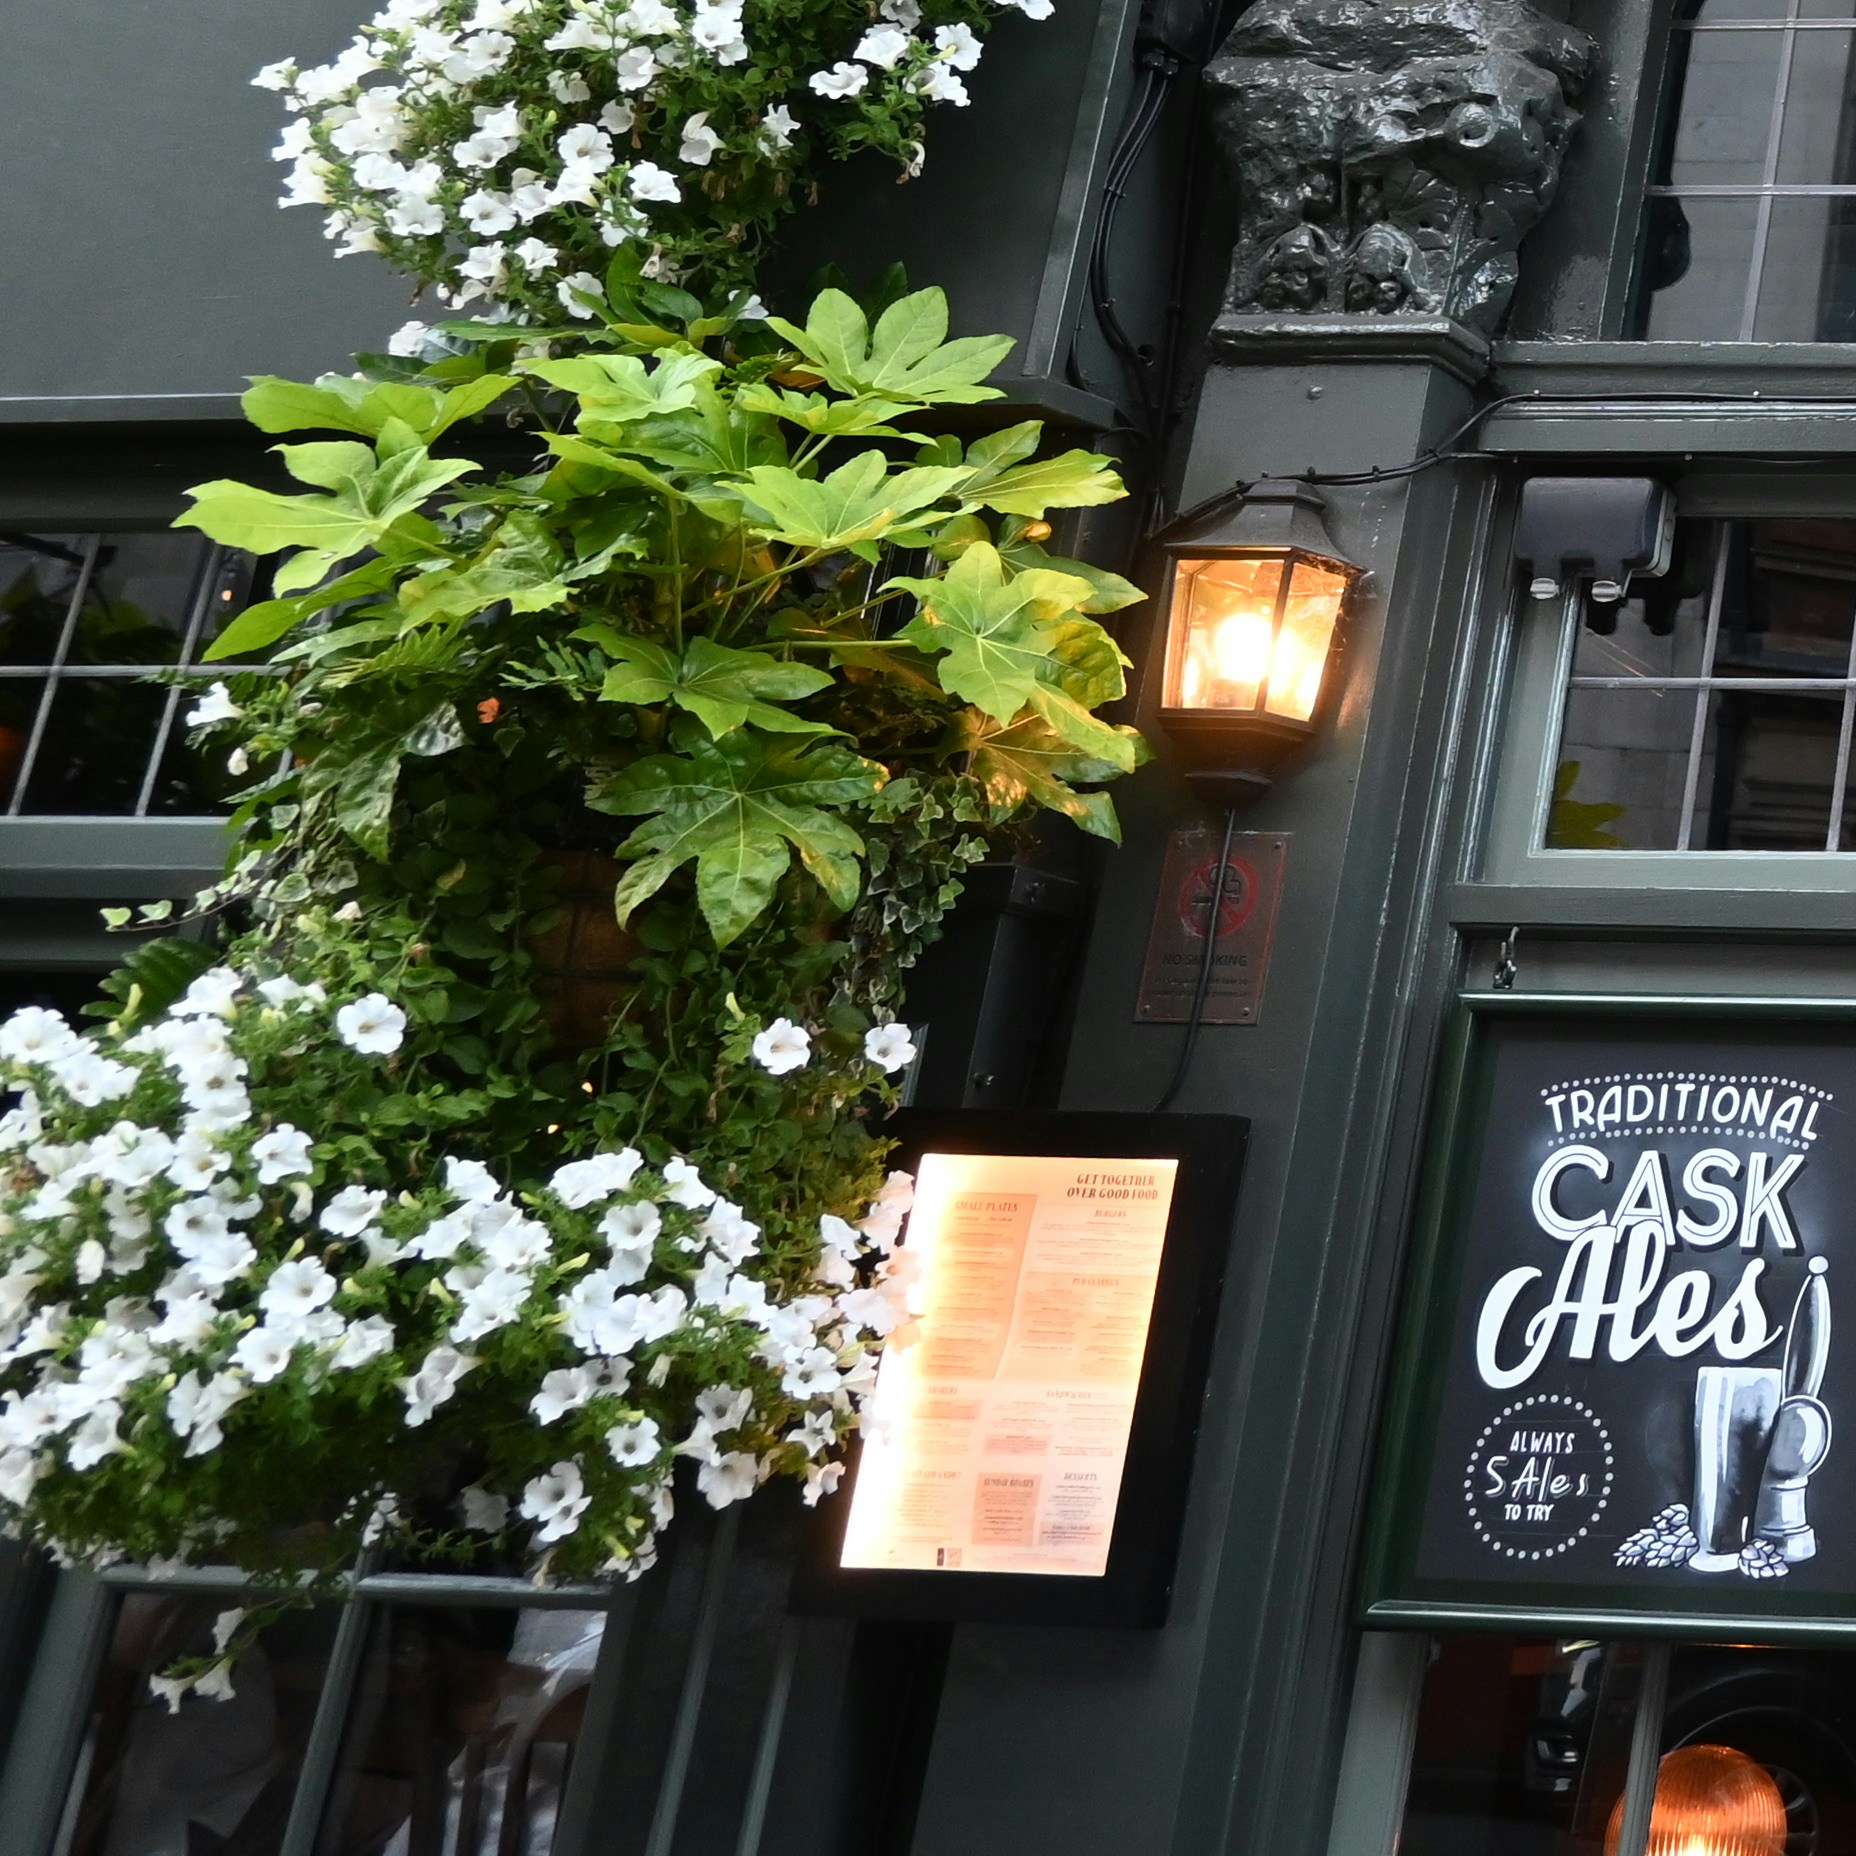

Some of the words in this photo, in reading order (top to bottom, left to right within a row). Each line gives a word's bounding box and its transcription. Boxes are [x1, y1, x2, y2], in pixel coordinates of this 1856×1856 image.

[1544, 1082, 1820, 1141] TRADITIONAL
[1531, 1144, 1805, 1249] CASK
[1475, 1220, 1784, 1389] Ales
[1509, 1430, 1576, 1455] ALWAYS
[1504, 1503, 1522, 1522] TO
[1526, 1503, 1555, 1522] TRY
